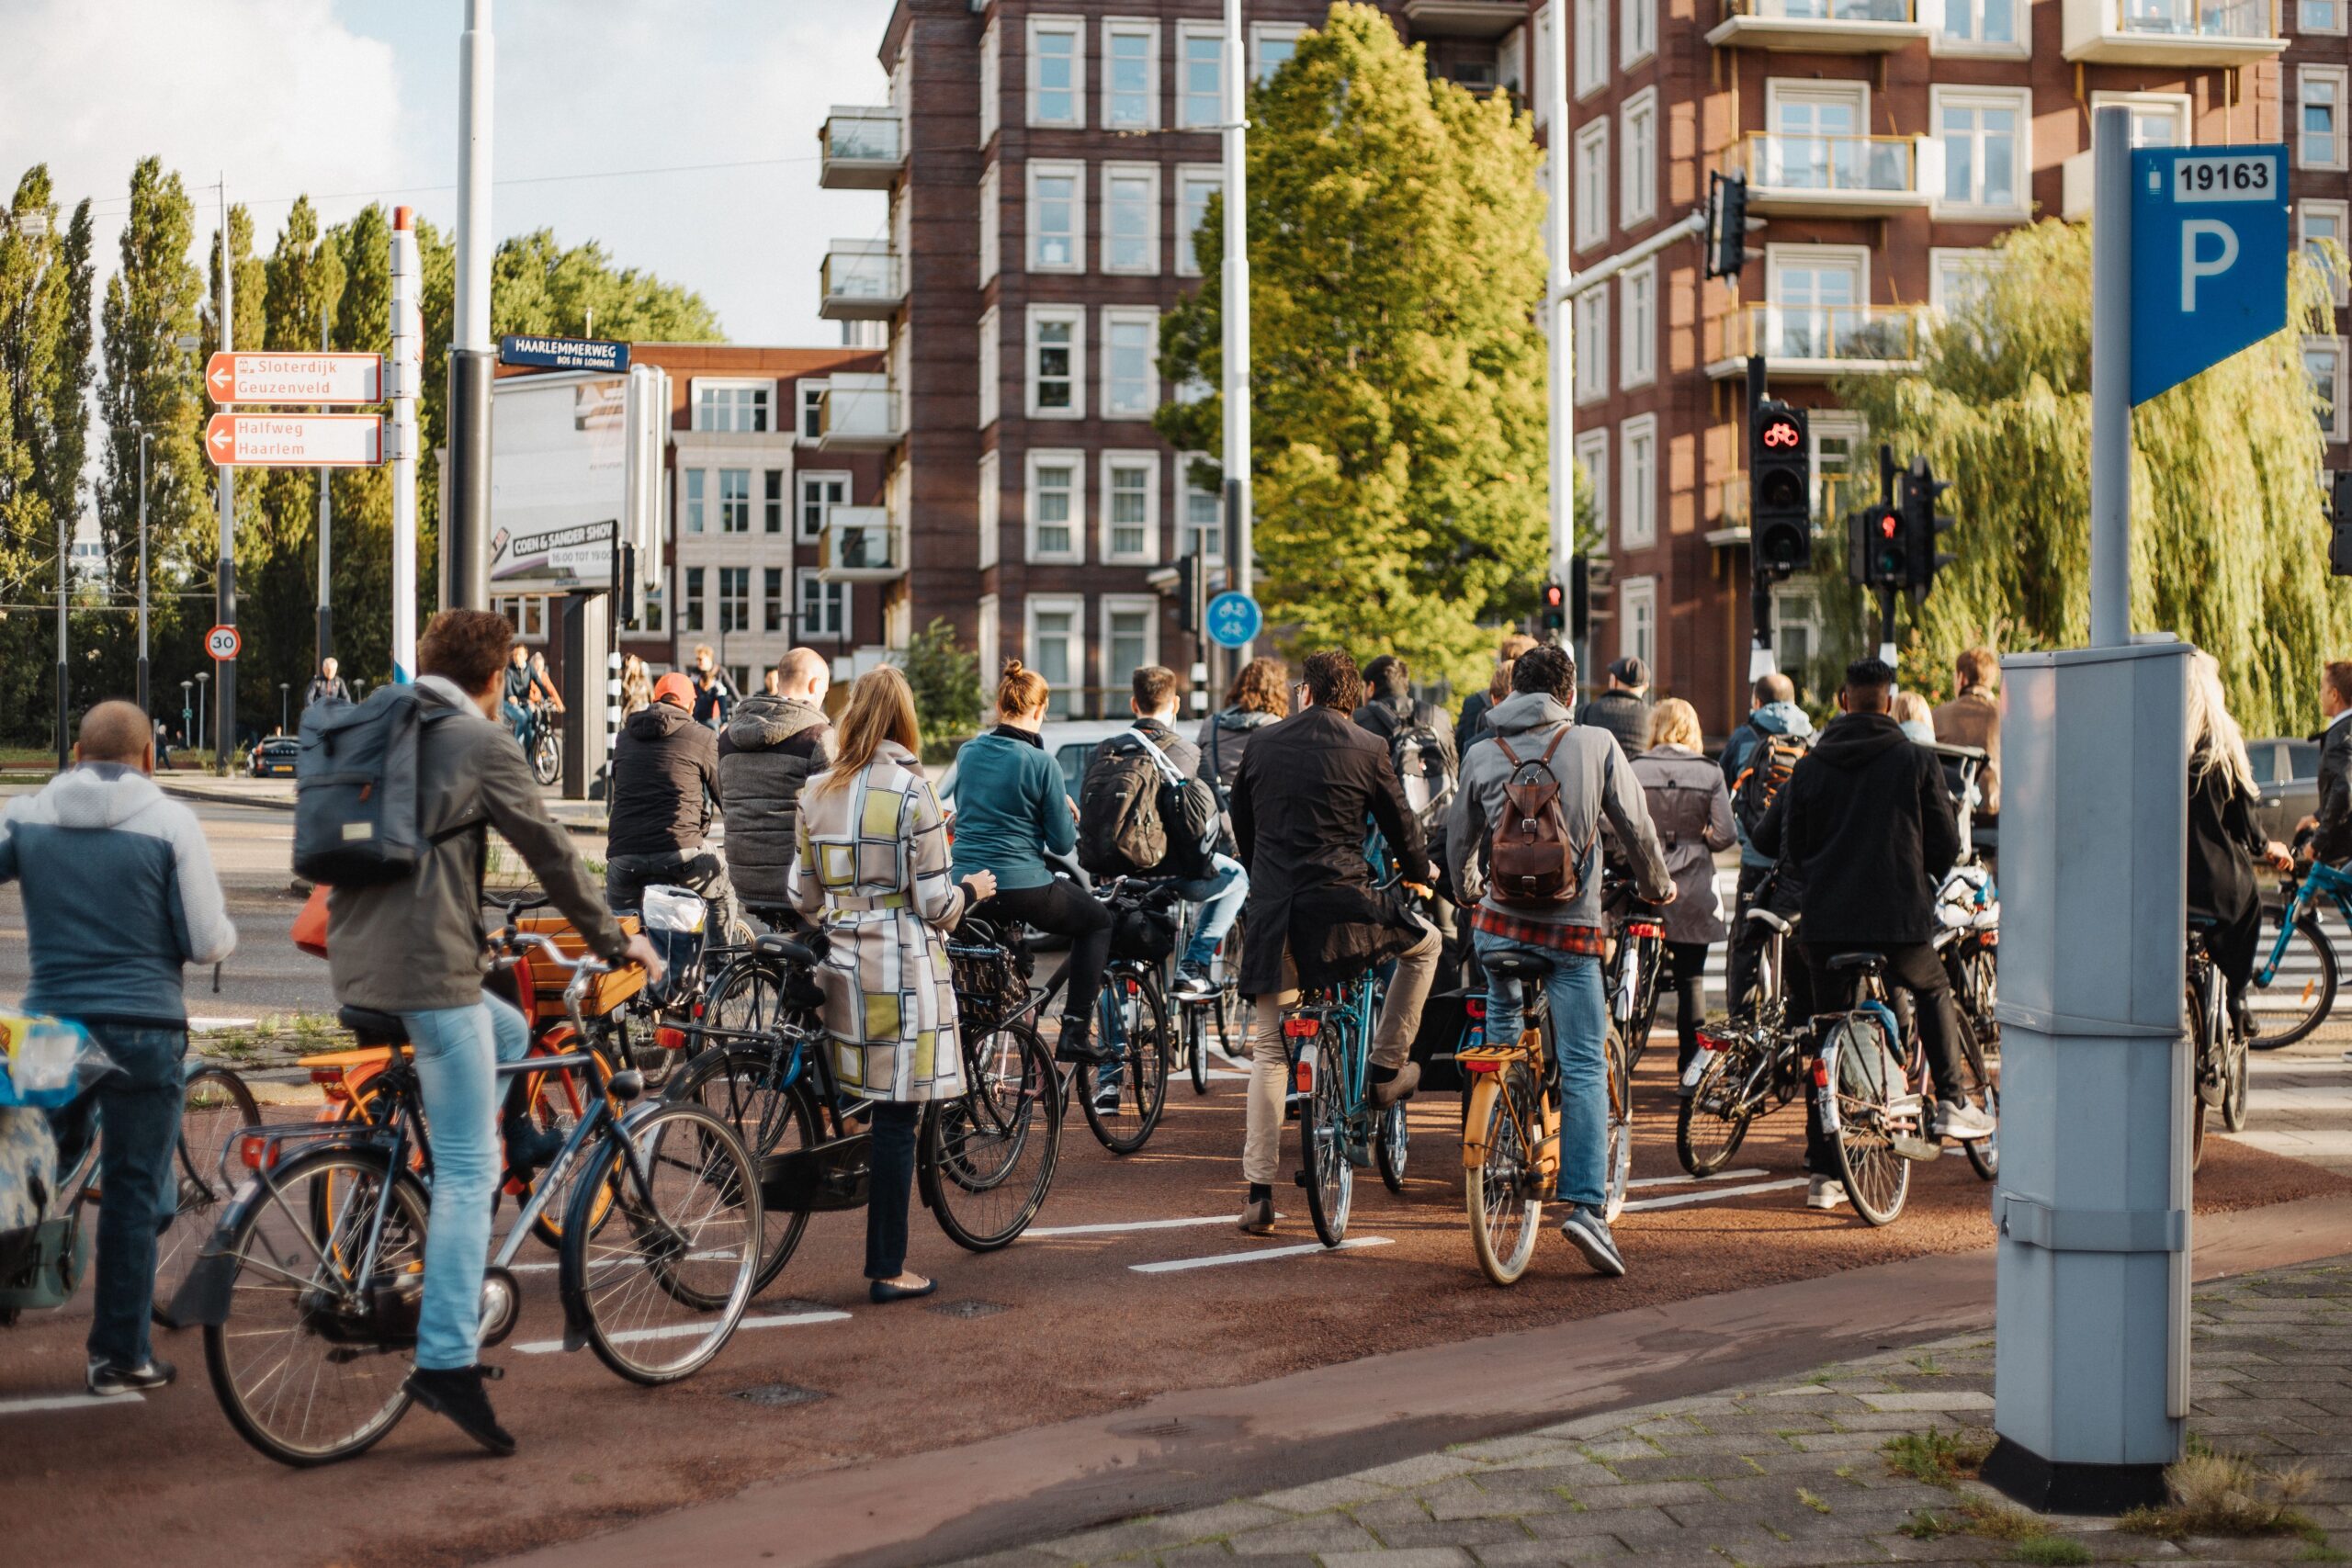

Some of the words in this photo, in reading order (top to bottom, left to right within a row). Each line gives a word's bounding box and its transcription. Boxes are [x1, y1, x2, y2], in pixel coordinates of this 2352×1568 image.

[2180, 163, 2268, 191] 19163
[2181, 219, 2240, 312] P
[515, 339, 616, 358] HAARLEMMERWEG
[259, 360, 337, 376] Sloterdijk
[557, 355, 571, 365] BOS
[572, 356, 582, 366] EN
[584, 357, 616, 367] LOMMER
[239, 381, 331, 394] Geuzenveld
[239, 422, 303, 436] Halfweg
[239, 443, 305, 455] Haarlem
[515, 537, 538, 555] COEN
[548, 527, 585, 547] SANDER
[212, 637, 234, 649] 30
